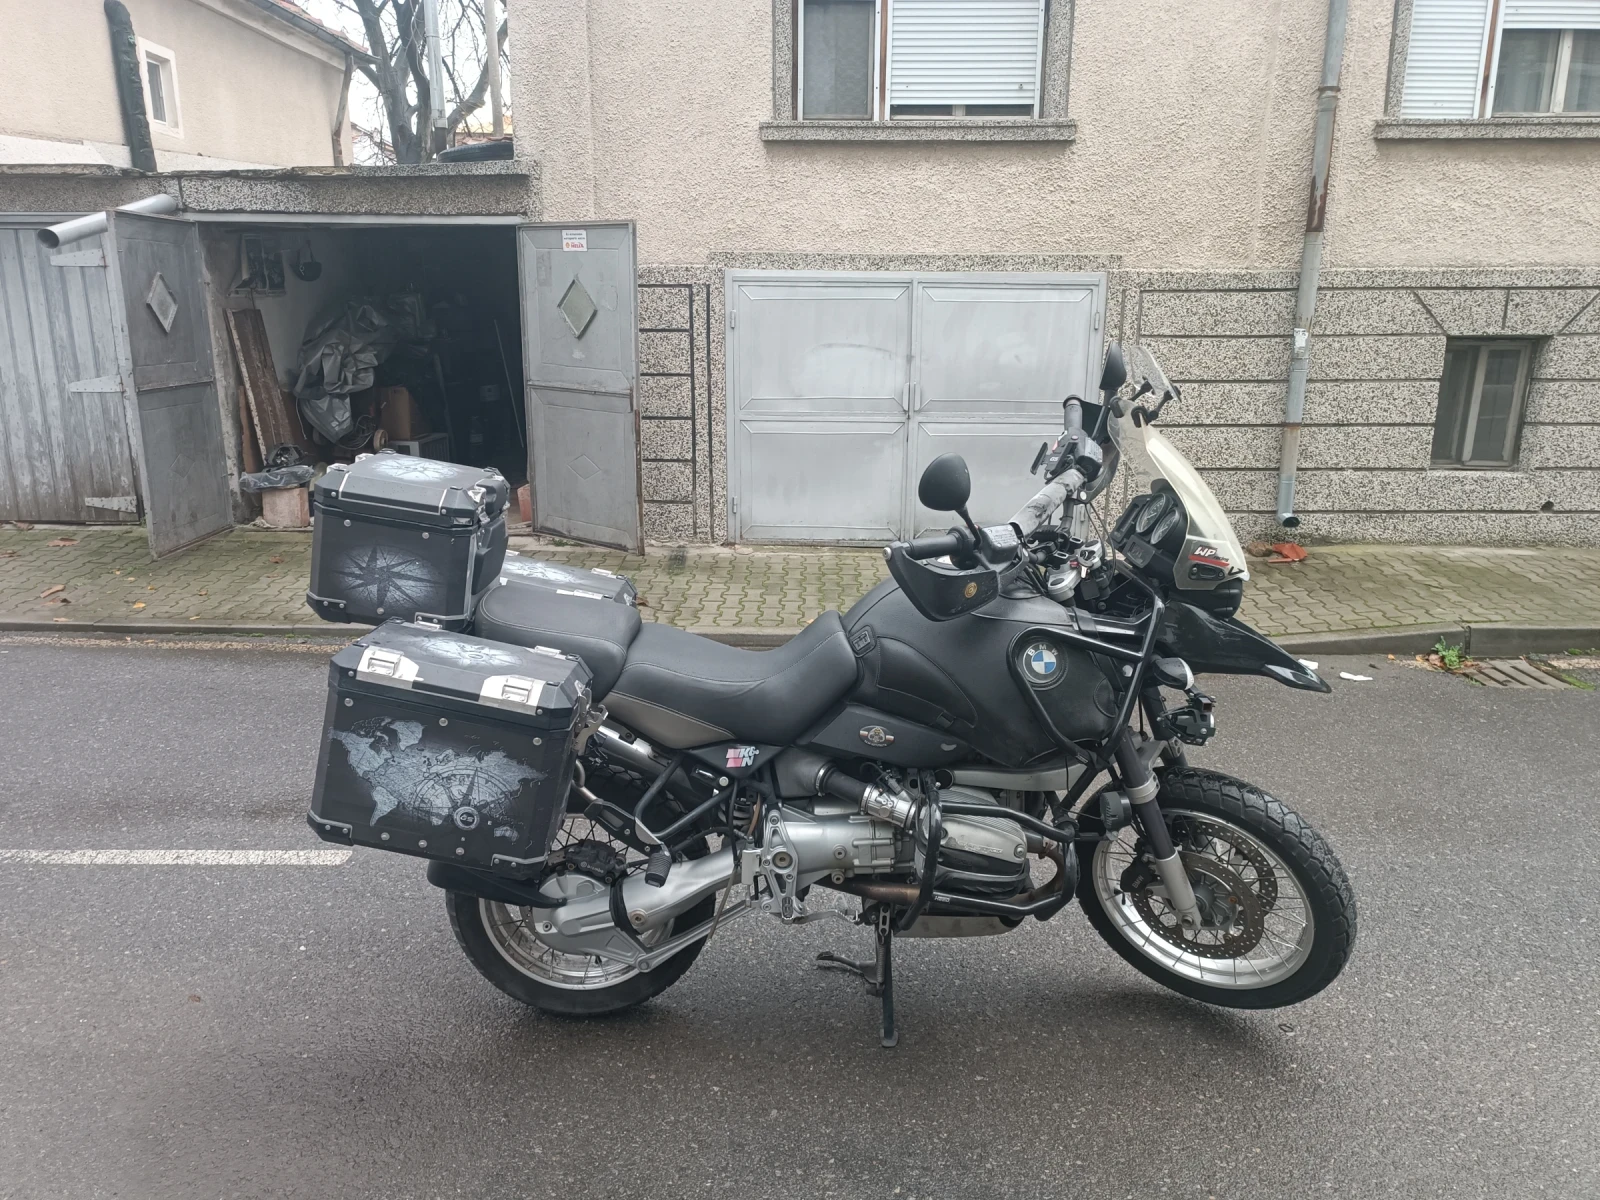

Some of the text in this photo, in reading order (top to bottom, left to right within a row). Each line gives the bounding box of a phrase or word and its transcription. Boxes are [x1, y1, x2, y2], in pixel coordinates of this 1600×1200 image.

[1193, 546, 1218, 557] WP
[1027, 644, 1058, 656] BMW
[1131, 875, 1144, 889] BMW
